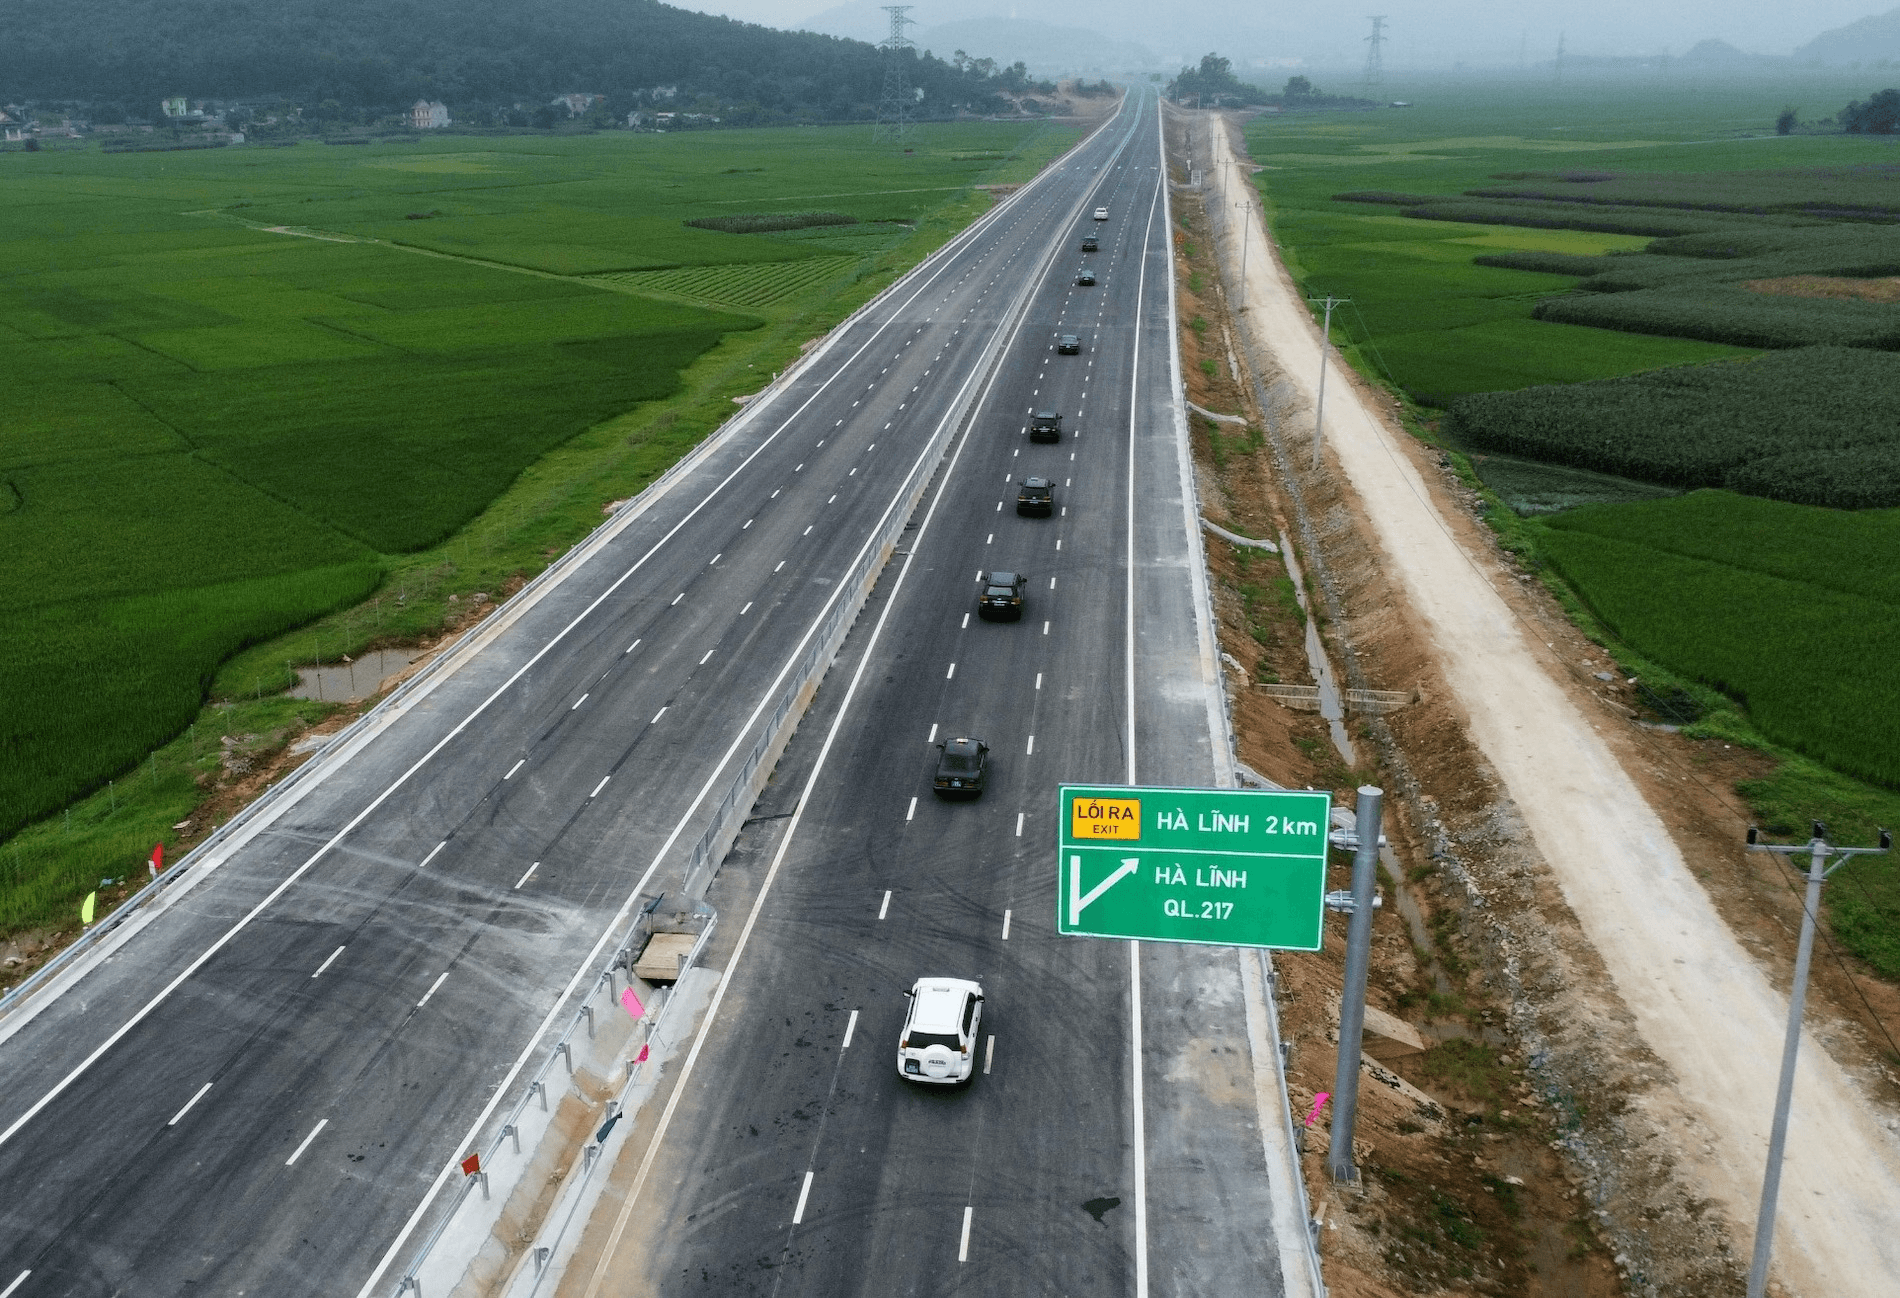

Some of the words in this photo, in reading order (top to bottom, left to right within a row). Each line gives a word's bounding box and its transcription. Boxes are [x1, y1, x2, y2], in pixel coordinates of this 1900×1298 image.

[1078, 799, 1103, 819] LỐI
[1109, 806, 1134, 820] RA
[1093, 824, 1119, 834] EXIT
[1157, 807, 1189, 831] HÀ
[1198, 809, 1250, 834] LĨNH
[1154, 862, 1187, 886] HÀ
[1196, 864, 1247, 889] LĨNH
[1163, 899, 1234, 920] QL.217
